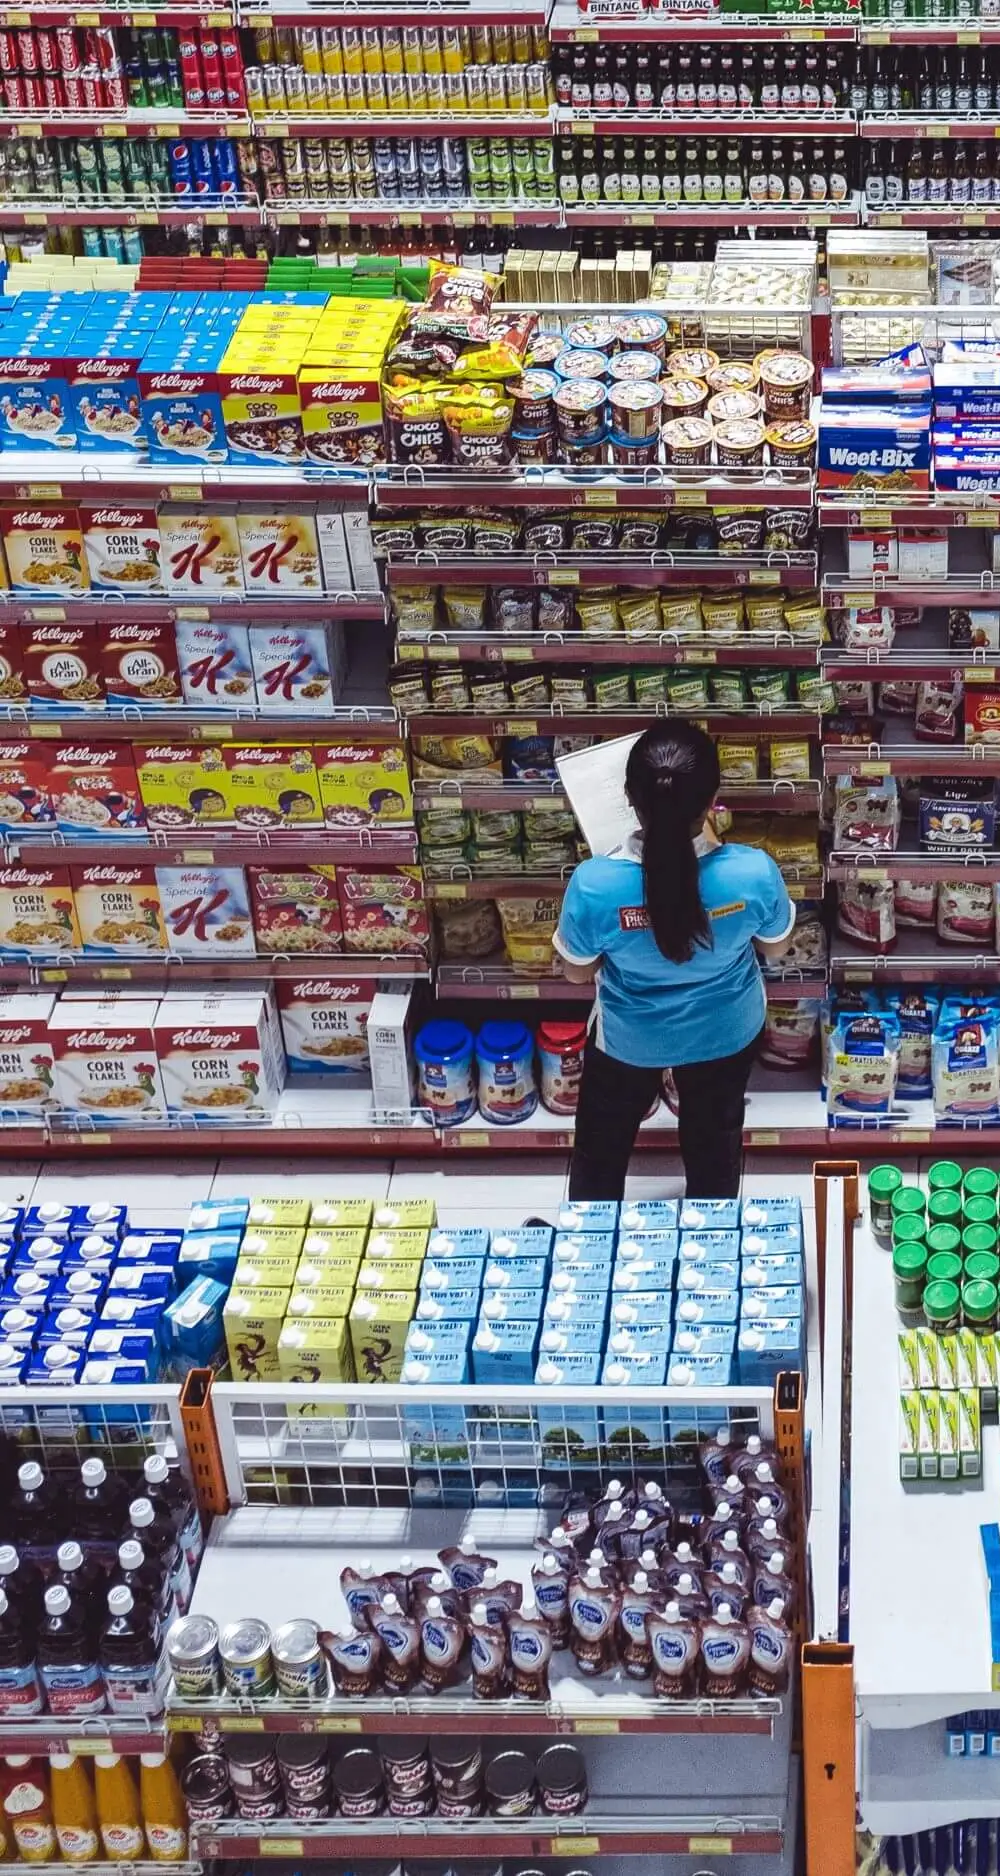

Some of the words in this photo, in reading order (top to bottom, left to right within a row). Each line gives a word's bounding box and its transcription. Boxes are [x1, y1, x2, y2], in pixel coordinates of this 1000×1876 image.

[591, 2, 640, 13] BINTANG
[662, 0, 712, 10] BINTANG
[447, 277, 484, 287] CHOCO
[441, 283, 485, 300] CHIPS
[0, 357, 50, 373] Kellogg's
[77, 360, 131, 374] Kellogg's
[151, 374, 205, 389] Kellogg's
[230, 376, 284, 390] Kellogg's
[311, 385, 365, 399] Kellogg's
[403, 422, 439, 431] CHOCO
[400, 432, 443, 447] CHIPS
[463, 436, 497, 444] CHOCO
[461, 443, 503, 456] CHIPS
[830, 448, 915, 467] Weet-Bix
[12, 514, 65, 526] Kellogg's
[91, 512, 144, 525] Kellogg's
[29, 536, 56, 546] CORN
[106, 535, 138, 546] CORN
[166, 532, 201, 542] Special
[244, 532, 279, 542] Special
[30, 546, 57, 554] FLAKES
[107, 545, 140, 556] FLAKES
[171, 535, 221, 585] K
[249, 535, 298, 583] K
[32, 627, 83, 641] Kellogg's
[110, 625, 161, 639] Kellogg's
[184, 644, 217, 654] Special
[55, 660, 75, 671] All-
[132, 658, 152, 669] All-
[50, 668, 82, 678] Bran
[127, 665, 157, 676] Bran
[188, 650, 235, 695] K
[262, 654, 311, 700] K
[56, 747, 117, 764] Kellogg's
[145, 748, 192, 760] Kellogg's
[235, 749, 282, 761] Kellogg's
[327, 747, 374, 760] Kellogg's
[945, 791, 967, 799] Ligo
[0, 868, 53, 883] Kellogg's
[83, 867, 142, 882] Kellogg's
[180, 872, 219, 884] Kellogg's
[100, 893, 133, 903] CORN
[165, 887, 209, 897] Special
[12, 894, 44, 905] CORN
[14, 903, 47, 913] FLAKES
[102, 902, 135, 912] FLAKES
[169, 889, 230, 941] K
[293, 981, 360, 998] Kellogg's
[310, 1010, 347, 1022] CORN
[312, 1020, 349, 1031] FLAKES
[0, 1026, 32, 1041] ogg's
[172, 1030, 242, 1048] Kellogg's
[67, 1031, 136, 1049] Kellogg's
[0, 1064, 24, 1073] AKES
[86, 1060, 125, 1073] CORN
[191, 1059, 229, 1071] CORN
[89, 1071, 126, 1081] FLAKES
[193, 1069, 230, 1080] FLAKES
